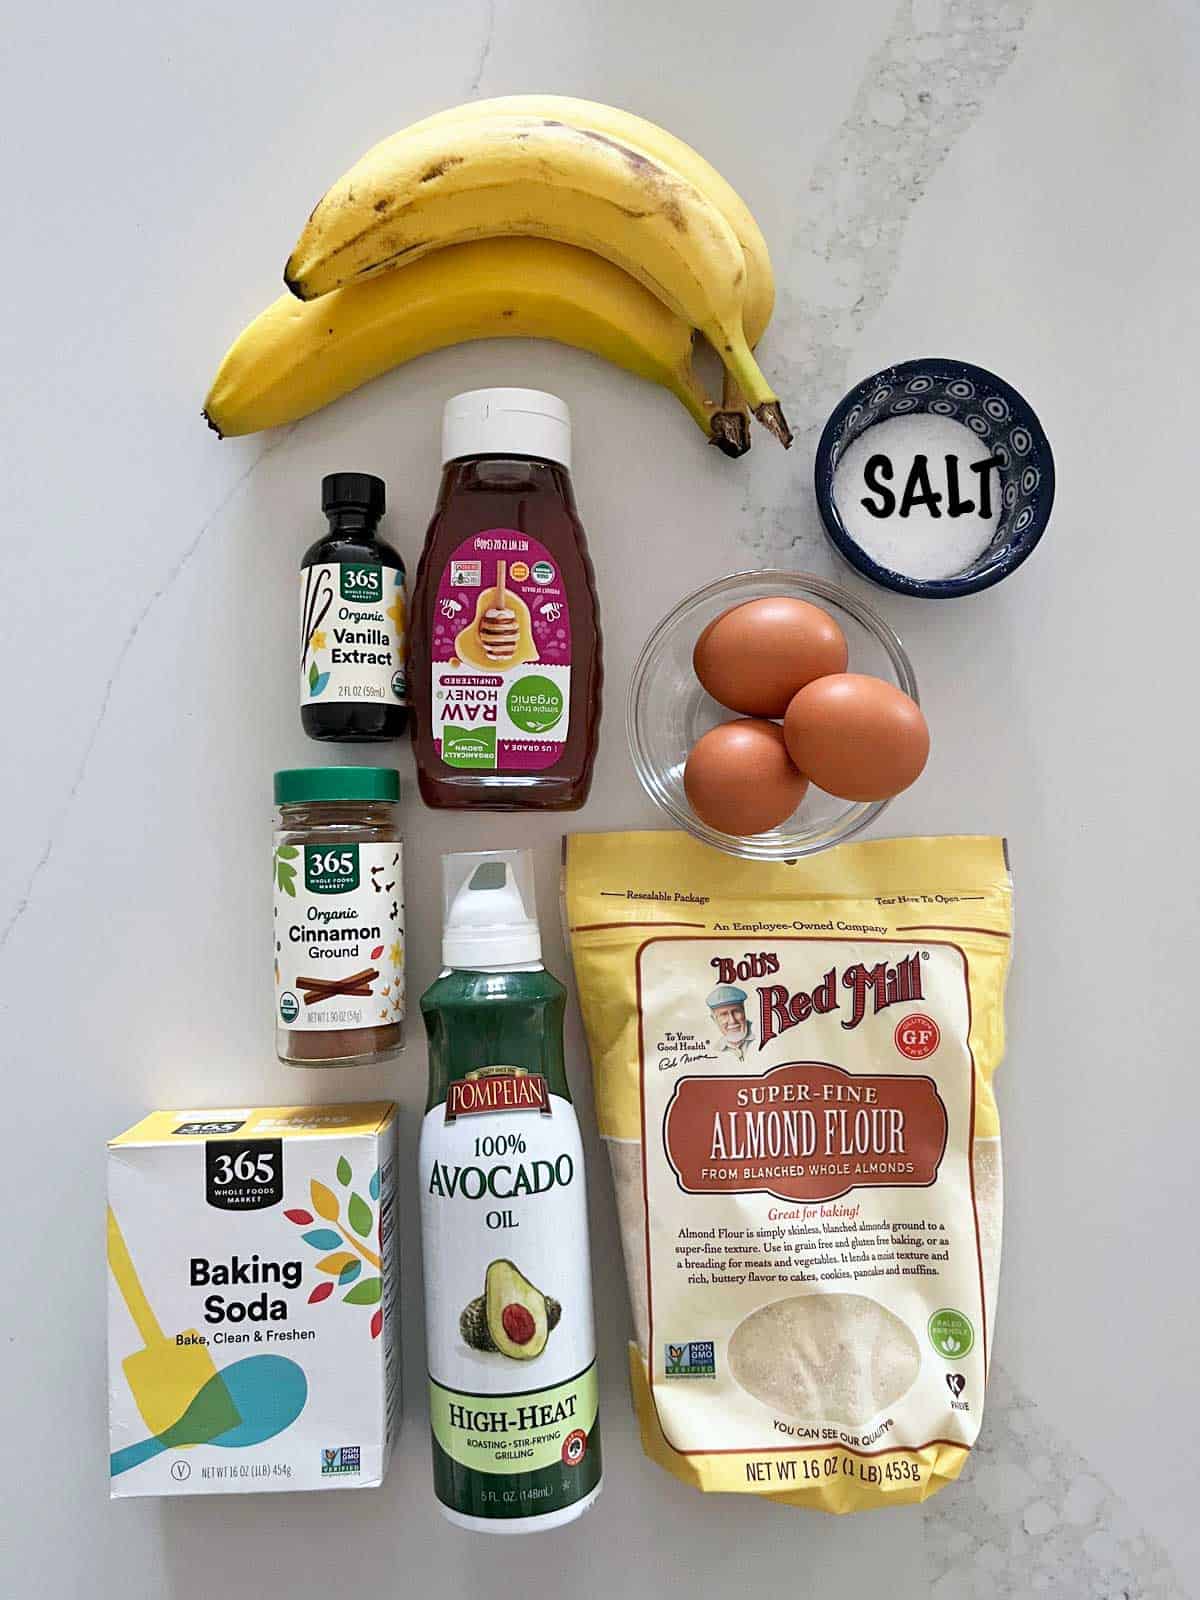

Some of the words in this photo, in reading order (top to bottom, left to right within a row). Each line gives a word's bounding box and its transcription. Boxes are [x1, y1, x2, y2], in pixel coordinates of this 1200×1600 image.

[494, 540, 501, 550] OZ
[509, 540, 517, 551] WT
[519, 541, 528, 551] NET
[344, 570, 378, 589] 365
[338, 607, 384, 624] Organic
[333, 628, 389, 645] Vanilla
[332, 648, 392, 666] Extract
[338, 687, 343, 696] 2
[344, 687, 351, 696] FL
[353, 686, 361, 696] OZ
[446, 690, 497, 700] HONEY
[511, 694, 558, 706] organic
[440, 704, 496, 721] RAW
[533, 704, 558, 713] simple
[310, 851, 353, 876] 365
[626, 890, 672, 900] Resealable
[674, 892, 710, 904] Package
[307, 906, 358, 924] Organic
[289, 926, 380, 942] Cinnamon
[713, 922, 729, 931] An
[732, 921, 833, 932] Employee-Owned
[836, 921, 888, 934] Company
[308, 945, 358, 958] Ground
[710, 952, 780, 985] Bob's
[756, 967, 840, 1051] Red
[665, 1032, 674, 1040] To
[676, 1032, 694, 1040] Your
[657, 1042, 678, 1051] Good
[451, 1078, 543, 1110] POMPEIAN
[737, 1084, 878, 1107] SUPER-FINE
[710, 1110, 816, 1160] ALMOND
[824, 1108, 904, 1156] FLOUR
[474, 1133, 526, 1157] 100%
[214, 1150, 274, 1185] 365
[701, 1168, 738, 1179] FROM
[744, 1165, 804, 1179] BLANCHED
[808, 1164, 849, 1176] WHOLE
[855, 1162, 914, 1174] ALMONDS
[429, 1154, 573, 1200] AVOCADO
[486, 1210, 519, 1229] OIL
[768, 1208, 800, 1220] Great
[801, 1206, 817, 1222] for
[820, 1204, 860, 1219] baking!
[678, 1228, 715, 1239] Almond
[719, 1228, 744, 1238] Flour
[746, 1228, 754, 1238] is
[756, 1227, 785, 1240] simply
[823, 1222, 857, 1233] blanched
[892, 1220, 925, 1232] ground
[928, 1222, 937, 1230] to
[675, 1243, 722, 1254] super-fine
[724, 1245, 760, 1254] texture.
[763, 1242, 781, 1253] Use
[783, 1241, 792, 1252] in
[794, 1240, 816, 1254] grain
[818, 1239, 833, 1248] free
[835, 1238, 849, 1248] and
[851, 1237, 875, 1249] gluten
[890, 1234, 924, 1248] baking,
[926, 1237, 937, 1245] or
[685, 1258, 726, 1271] breading
[728, 1258, 741, 1268] for
[745, 1259, 772, 1268] meats
[774, 1256, 792, 1267] and
[841, 1252, 848, 1263] It
[896, 1252, 929, 1260] texture
[931, 1250, 949, 1261] and
[190, 1254, 302, 1289] Baking
[688, 1274, 709, 1284] rich,
[712, 1273, 746, 1284] buttery
[748, 1272, 776, 1282] flavor
[778, 1274, 788, 1282] to
[790, 1271, 818, 1282] cakes,
[820, 1268, 852, 1280] cookies,
[886, 1264, 900, 1275] and
[902, 1264, 939, 1275] muffins.
[204, 1292, 287, 1323] Soda
[175, 1334, 210, 1346] Bake,
[213, 1332, 250, 1344] Clean
[254, 1330, 262, 1341] &
[266, 1329, 315, 1341] Freshen
[449, 1394, 577, 1432] HIGH-HEAT
[467, 1439, 507, 1449] ROASTING
[513, 1431, 561, 1448] STIR-FRYING
[773, 1420, 794, 1435] YOU
[797, 1428, 820, 1439] CAN
[822, 1429, 838, 1439] SEE
[840, 1432, 860, 1446] OUR
[495, 1449, 534, 1460] GRILLING
[202, 1466, 215, 1478] NET
[216, 1466, 228, 1478] WT
[229, 1466, 237, 1478] 16
[240, 1466, 249, 1477] OZ
[272, 1464, 292, 1478] 454g
[746, 1462, 772, 1481] NET
[776, 1461, 798, 1480] WT
[803, 1460, 820, 1478] 16
[824, 1456, 838, 1476] OZ
[842, 1457, 855, 1476] (1
[860, 1464, 882, 1484] LB)
[885, 1460, 920, 1481] 453g
